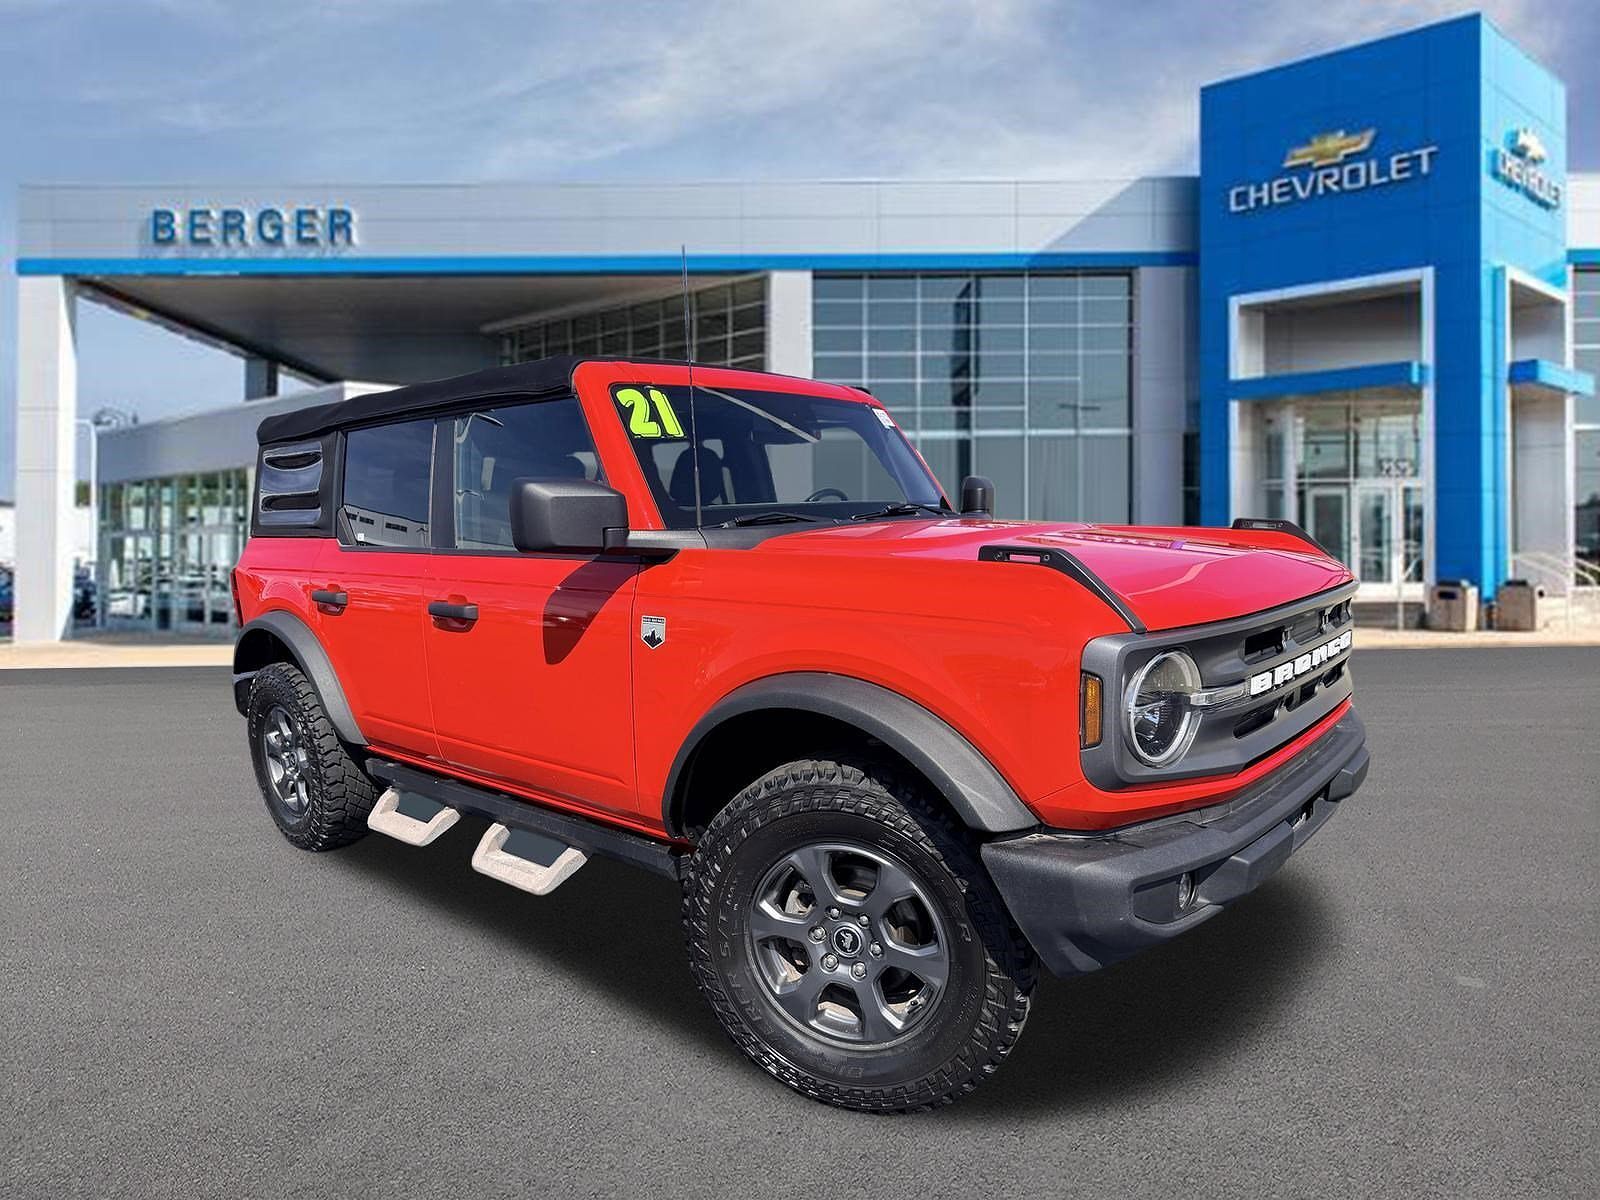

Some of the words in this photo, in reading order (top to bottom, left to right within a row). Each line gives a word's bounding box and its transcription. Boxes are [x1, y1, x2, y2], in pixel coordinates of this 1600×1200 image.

[1229, 146, 1438, 212] CHEVROLET
[152, 208, 357, 246] BERGER
[616, 388, 684, 437] 21
[1250, 630, 1352, 696] BRONCO
